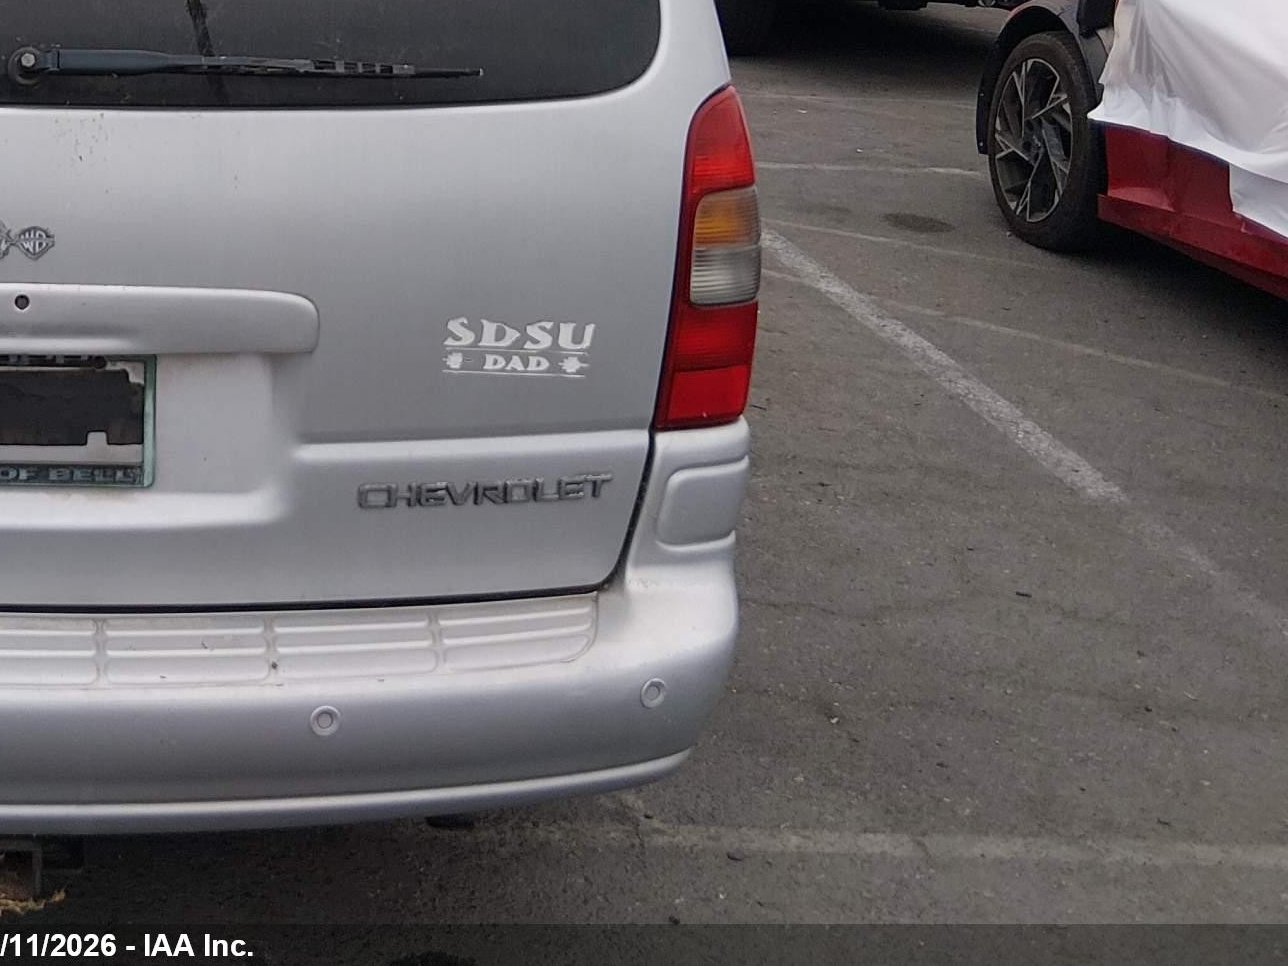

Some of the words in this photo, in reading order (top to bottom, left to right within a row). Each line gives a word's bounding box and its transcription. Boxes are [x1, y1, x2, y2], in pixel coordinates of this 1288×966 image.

[443, 317, 596, 350] SDSU
[482, 353, 550, 371] DAD
[356, 472, 614, 509] CHEVROLET
